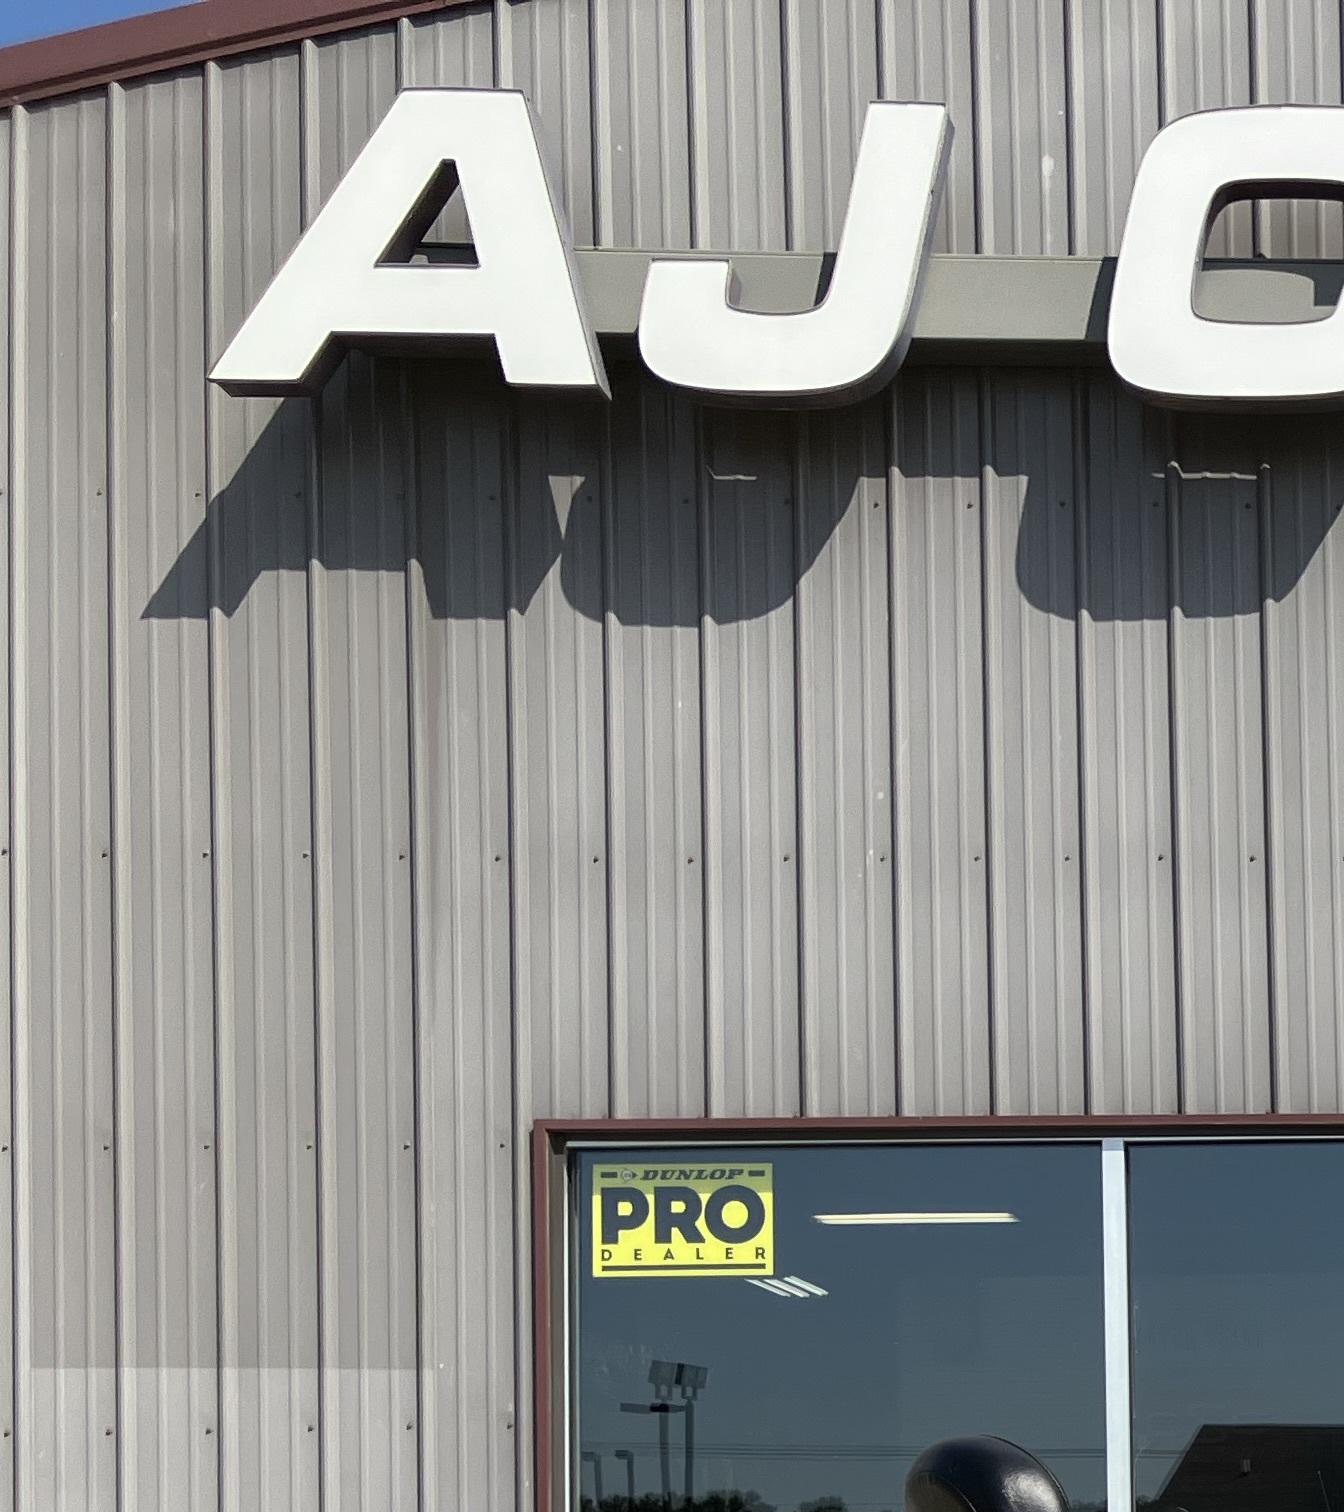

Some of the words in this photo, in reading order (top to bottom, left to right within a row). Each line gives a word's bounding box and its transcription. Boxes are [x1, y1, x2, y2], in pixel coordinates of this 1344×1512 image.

[641, 1168, 745, 1182] DUNLOP
[601, 1185, 766, 1245] PRO
[601, 1247, 766, 1261] DEALER
